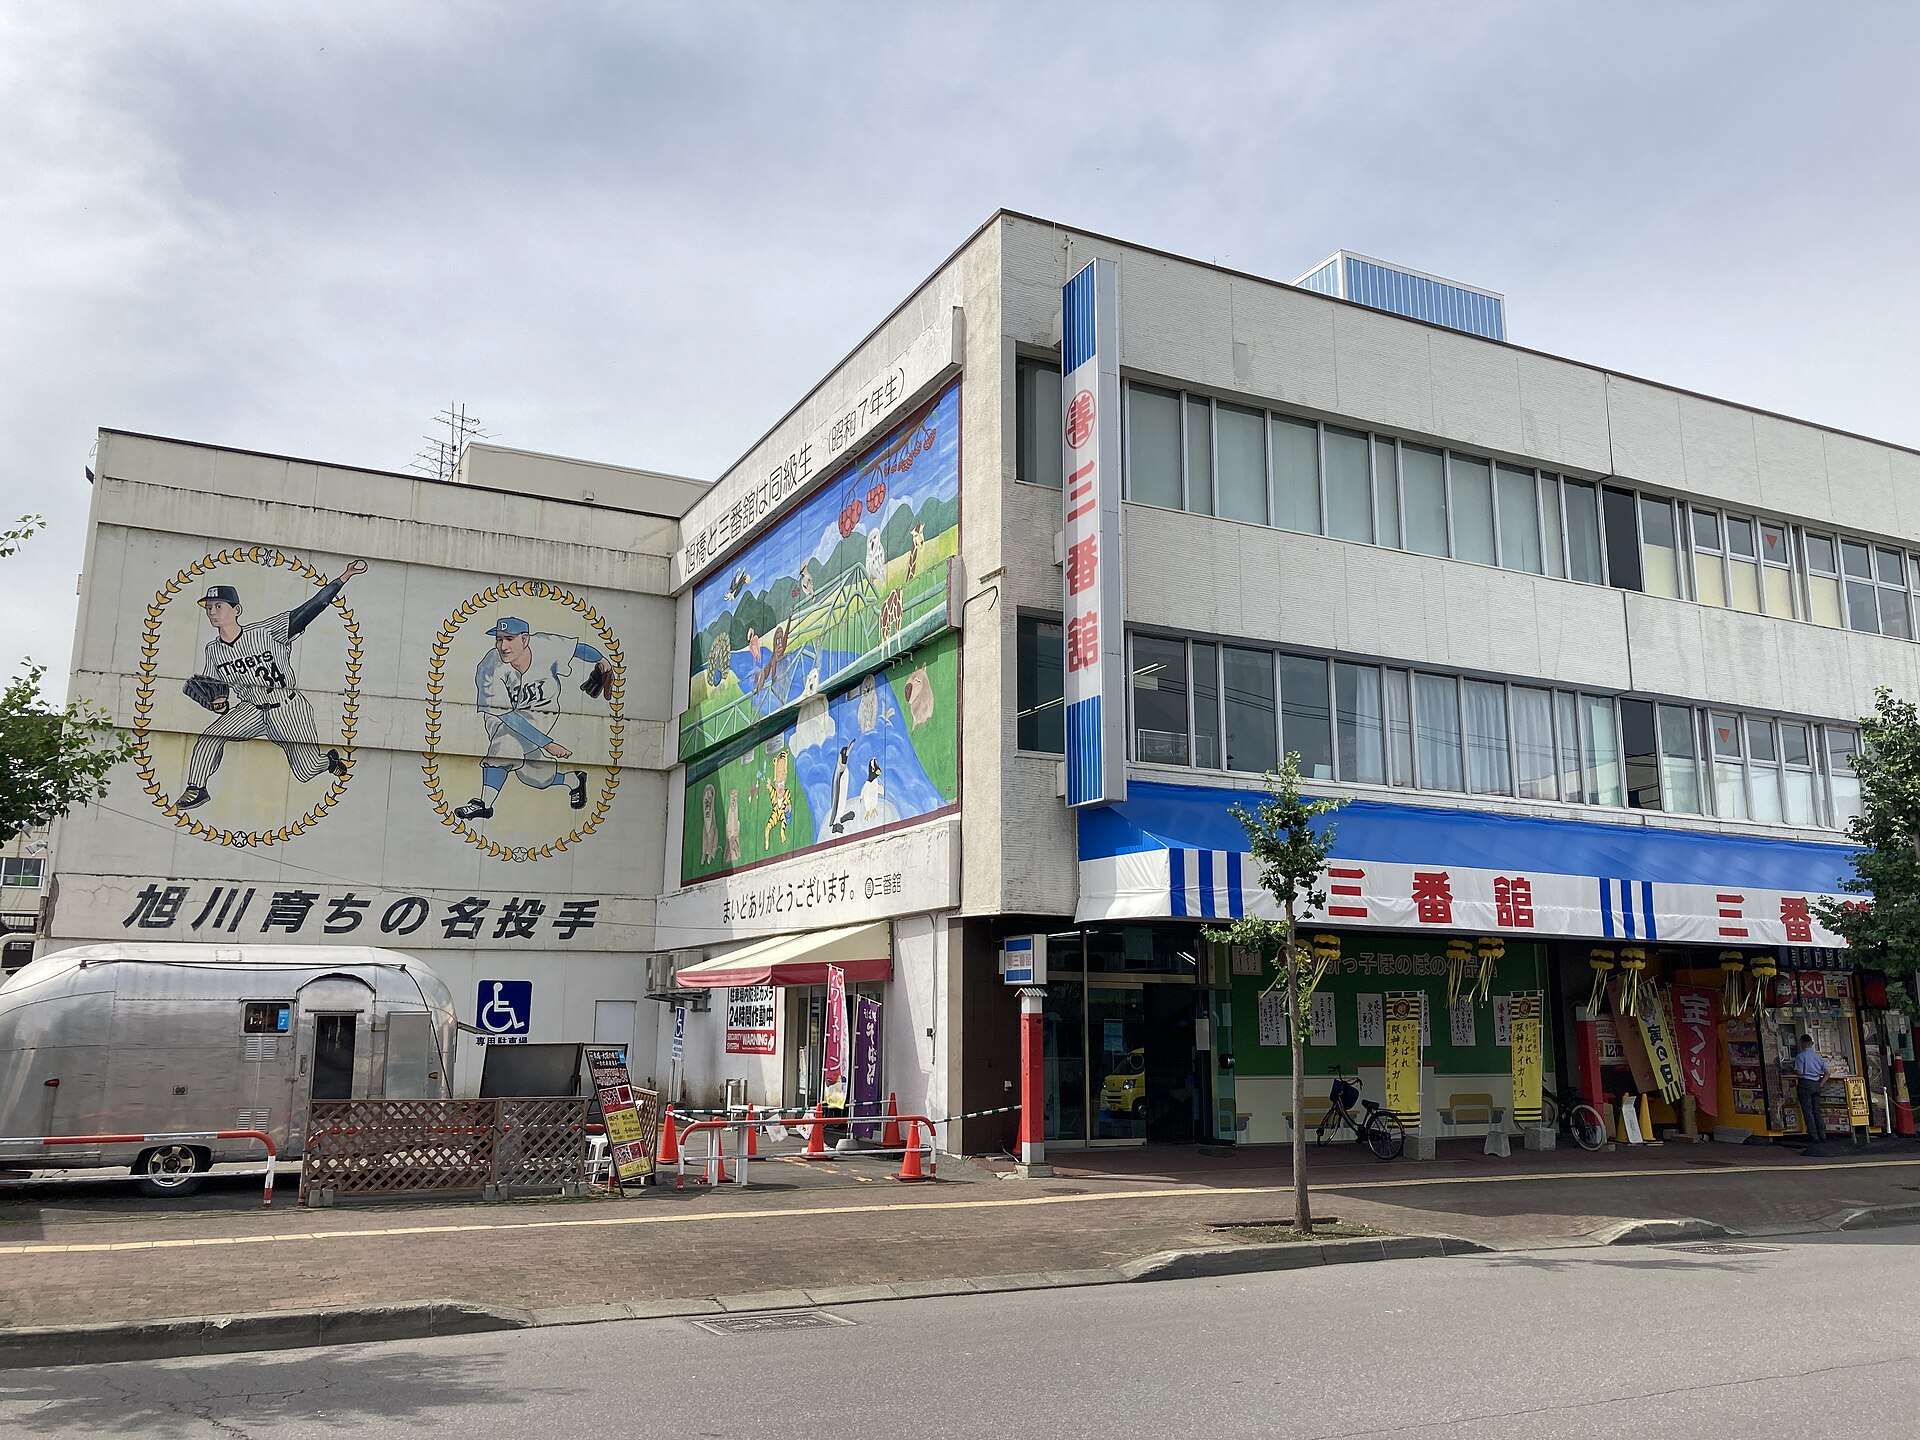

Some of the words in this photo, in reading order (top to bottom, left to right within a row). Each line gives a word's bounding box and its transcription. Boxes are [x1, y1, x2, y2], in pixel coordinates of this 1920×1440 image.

[217, 650, 274, 677] Tigers
[255, 662, 287, 694] 34
[123, 884, 600, 940] 旭川育ちの名投手
[723, 870, 855, 924] まいどありがとうございます。
[1716, 894, 1870, 944] 三番
[729, 1005, 774, 1027] 24時間作動中
[742, 1033, 768, 1045] WARNING
[1391, 1024, 1401, 1103] 阪神タイガース
[1515, 1022, 1527, 1098] 阪神タイガース
